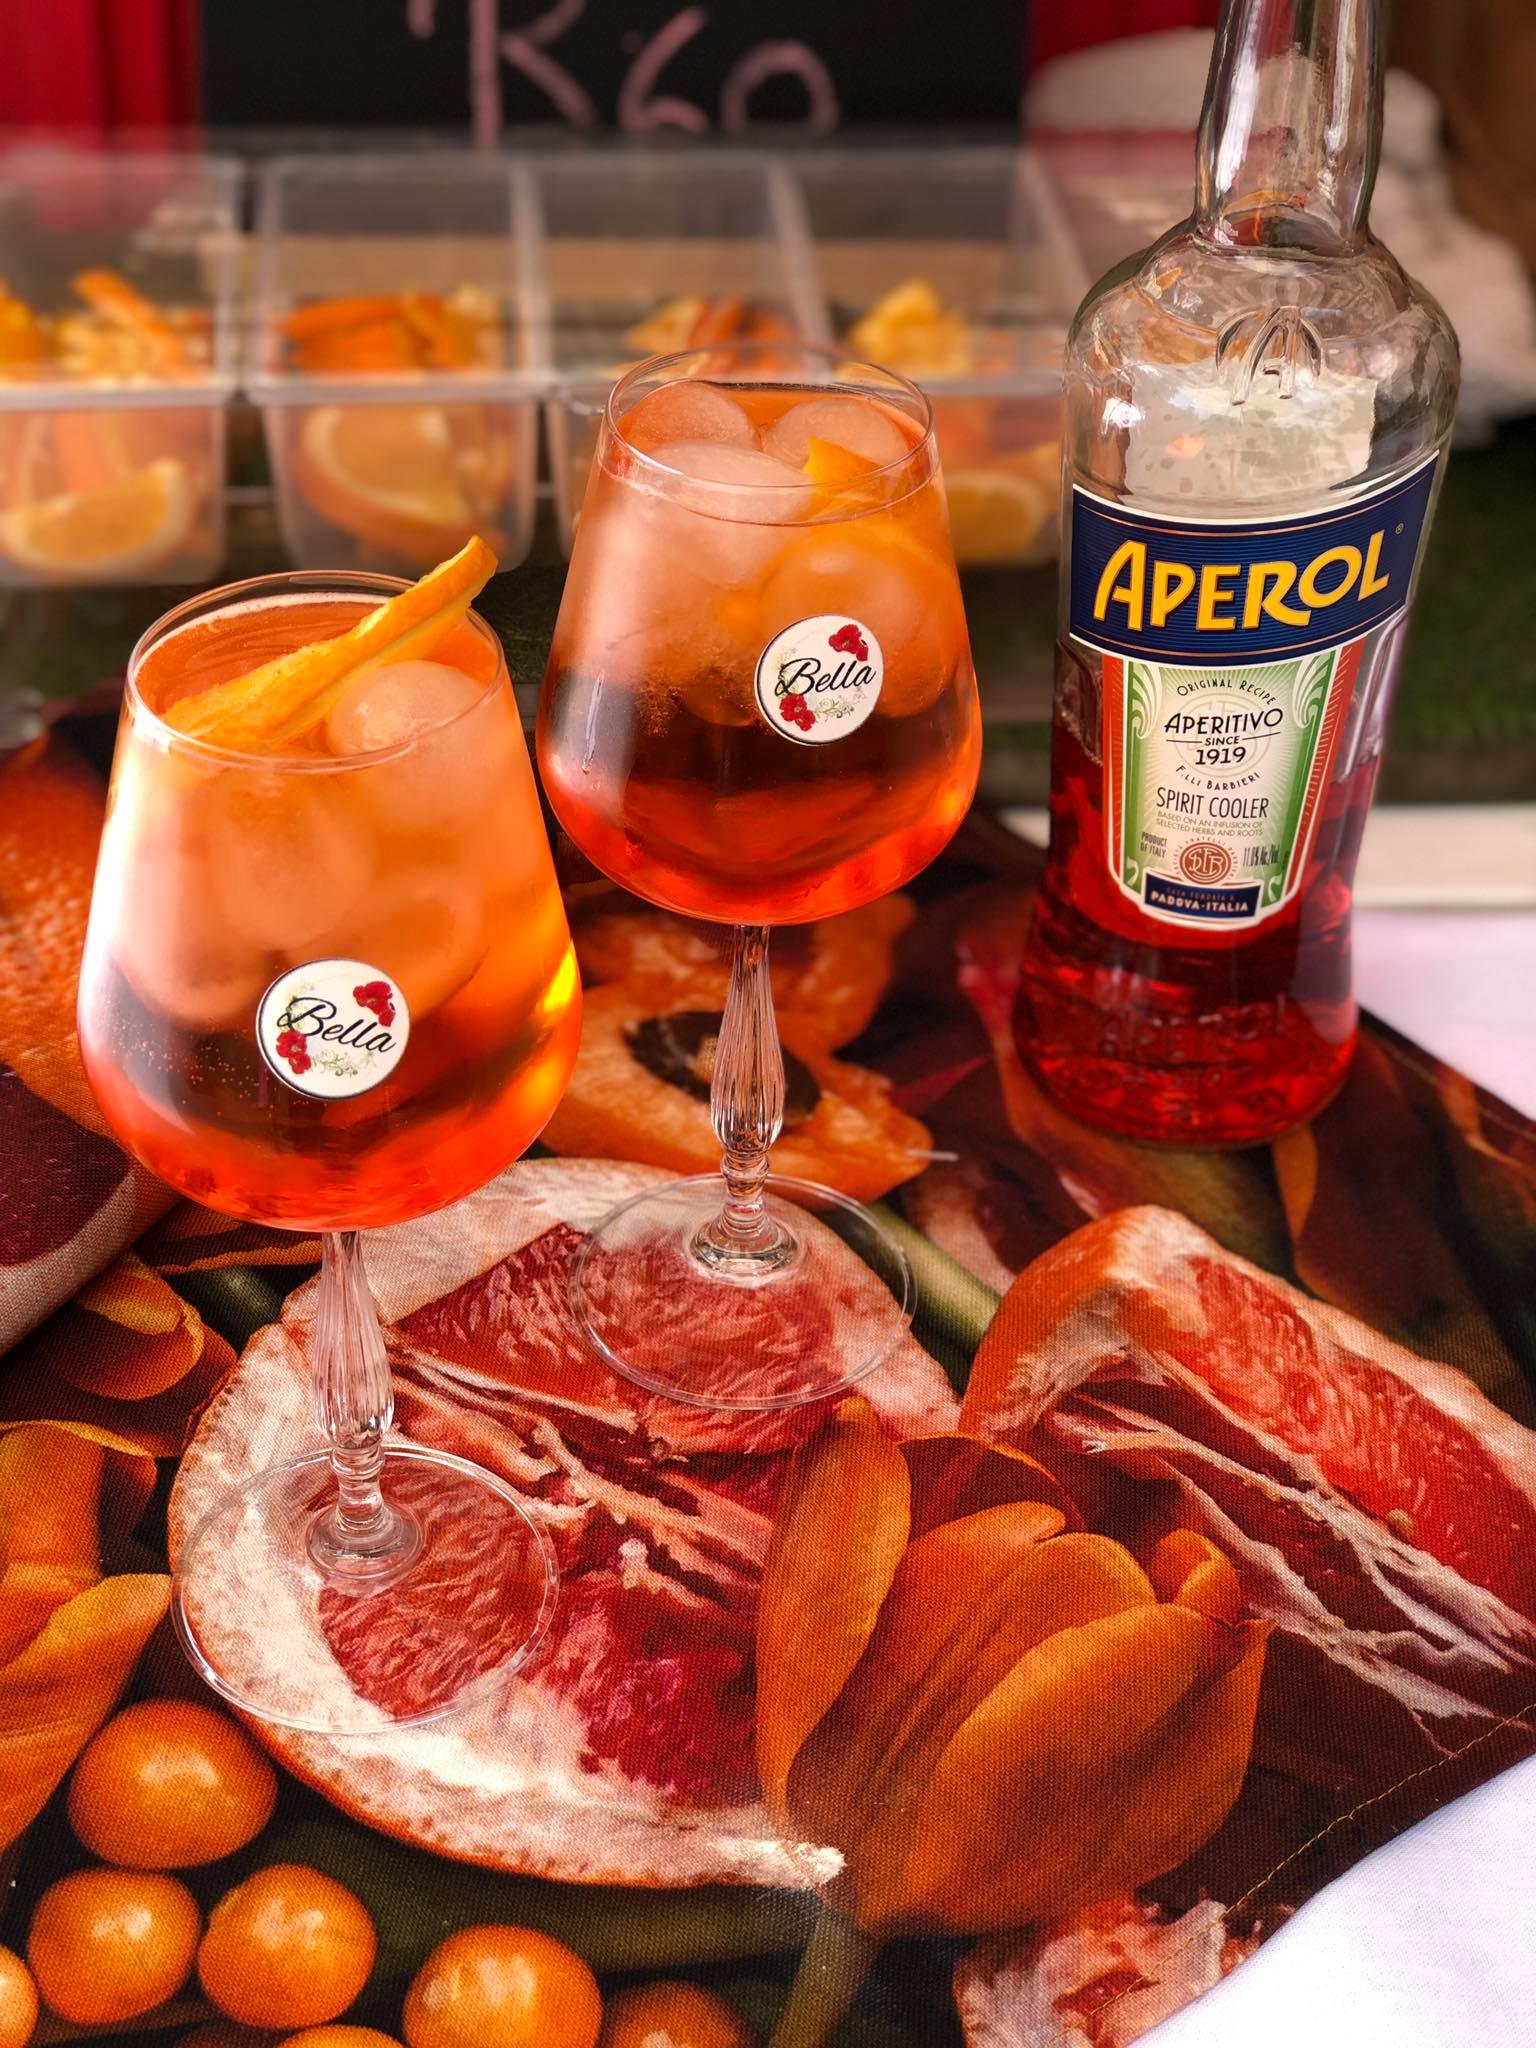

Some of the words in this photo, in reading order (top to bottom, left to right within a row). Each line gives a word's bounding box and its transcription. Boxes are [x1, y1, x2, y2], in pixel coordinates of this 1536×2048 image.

[1093, 529, 1391, 632] APEROL
[774, 657, 877, 697] Bella
[1177, 678, 1233, 697] ORIGINAL
[1239, 680, 1277, 706] RECIPE
[1164, 708, 1284, 735] APERITIVO
[1204, 735, 1240, 747] SINCE
[1195, 746, 1247, 765] 1919
[1206, 771, 1261, 791] BARBIERI
[1156, 786, 1205, 816] SPIRIT
[1209, 797, 1270, 819] COOLER
[1156, 818, 1191, 833] SELECTED
[1191, 826, 1217, 836] HERBS
[1217, 828, 1236, 837] AND
[1236, 828, 1264, 837] ROOTS
[1157, 810, 1182, 822] BASED
[1183, 816, 1197, 826] ON
[1199, 819, 1212, 828] AN
[1213, 819, 1251, 829] INFUSION
[1252, 820, 1264, 829] OF
[276, 996, 397, 1053] Bella
